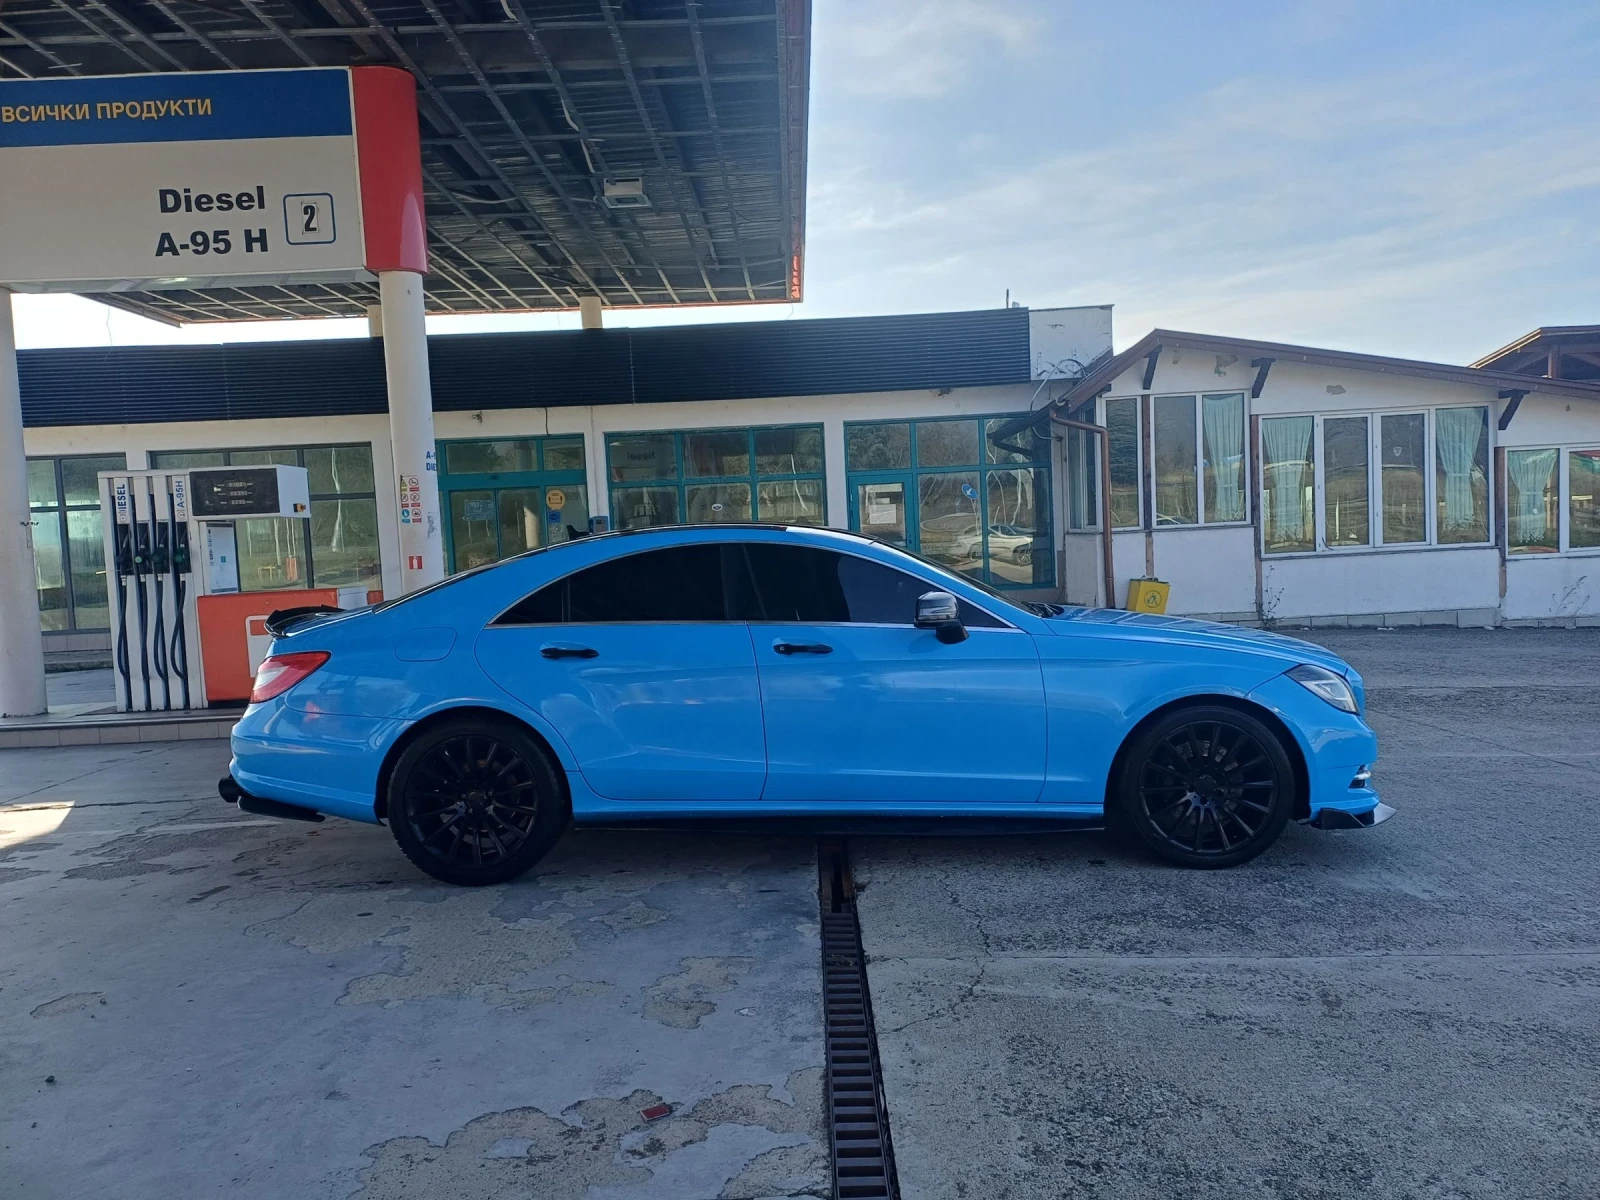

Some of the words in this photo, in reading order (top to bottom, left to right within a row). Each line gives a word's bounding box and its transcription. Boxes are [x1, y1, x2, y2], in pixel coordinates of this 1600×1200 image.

[1, 103, 90, 123] ВСИЧКИ
[96, 98, 212, 121] ПРОДУКТИ
[159, 185, 265, 213] Diesel
[303, 204, 317, 232] 2
[155, 229, 232, 257] A-95
